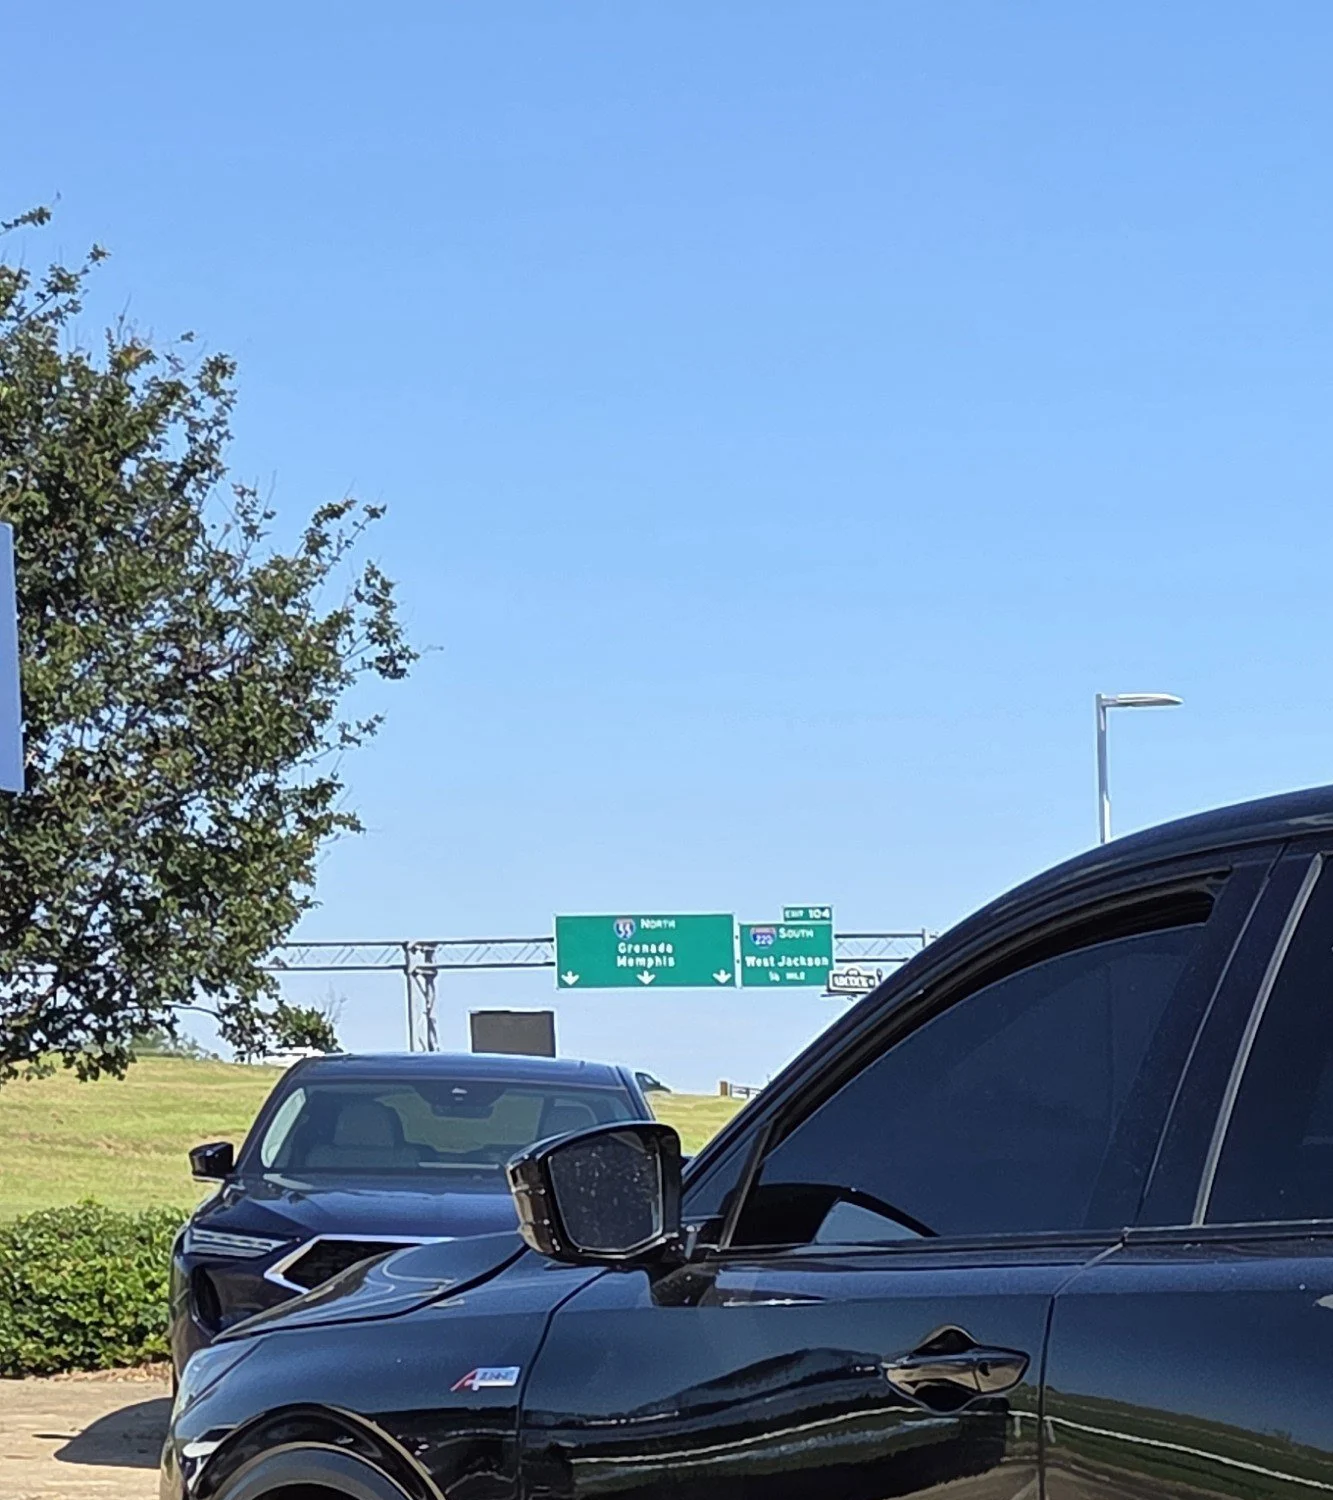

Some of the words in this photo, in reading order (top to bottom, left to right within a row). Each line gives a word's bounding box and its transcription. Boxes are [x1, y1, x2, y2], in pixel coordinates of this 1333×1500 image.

[808, 909, 830, 919] 104
[616, 923, 633, 938] 55
[641, 918, 676, 930] NORTH
[755, 934, 772, 945] 220
[778, 927, 814, 939] SOUTH
[618, 942, 673, 954] Grenada
[617, 955, 675, 969] Memphis
[745, 956, 775, 968] West
[777, 956, 829, 968] Jackson
